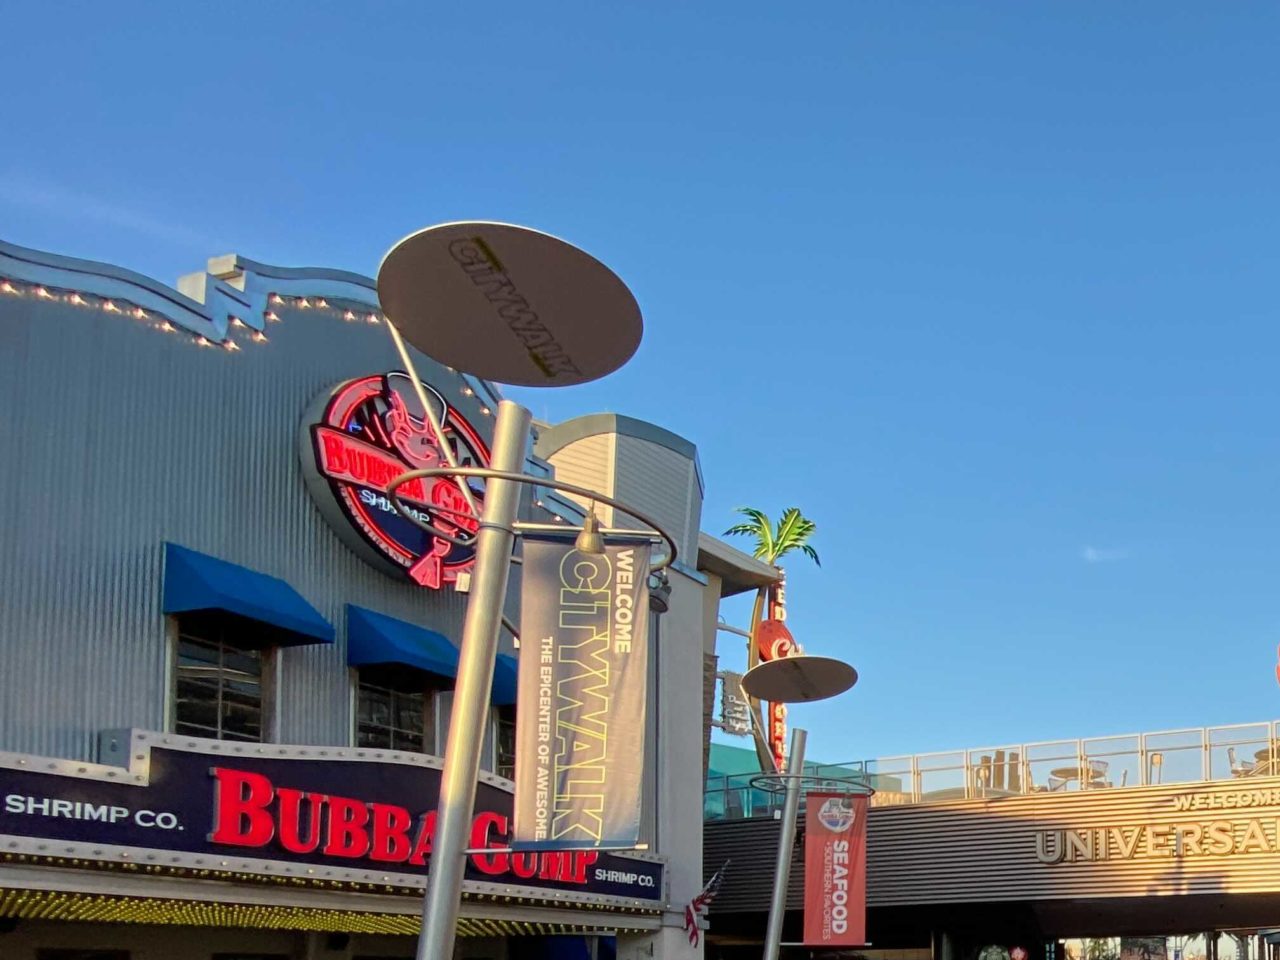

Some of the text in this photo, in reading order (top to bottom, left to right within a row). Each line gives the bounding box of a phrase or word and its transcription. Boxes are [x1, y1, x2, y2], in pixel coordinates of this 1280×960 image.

[449, 238, 582, 376] CITYWALK
[614, 549, 634, 654] WELCOME
[541, 636, 553, 664] THE
[552, 547, 612, 843] CITYWALK
[538, 665, 552, 742] EPICENTER
[537, 744, 550, 765] OF
[5, 794, 185, 831] SHRIMP CO.
[208, 767, 439, 866] BUBBA
[594, 868, 638, 885] SHRIMP
[638, 874, 655, 887] CO.
[822, 845, 833, 941] SOUTHERN FAVORITES
[832, 839, 849, 935] SEAFOOD
